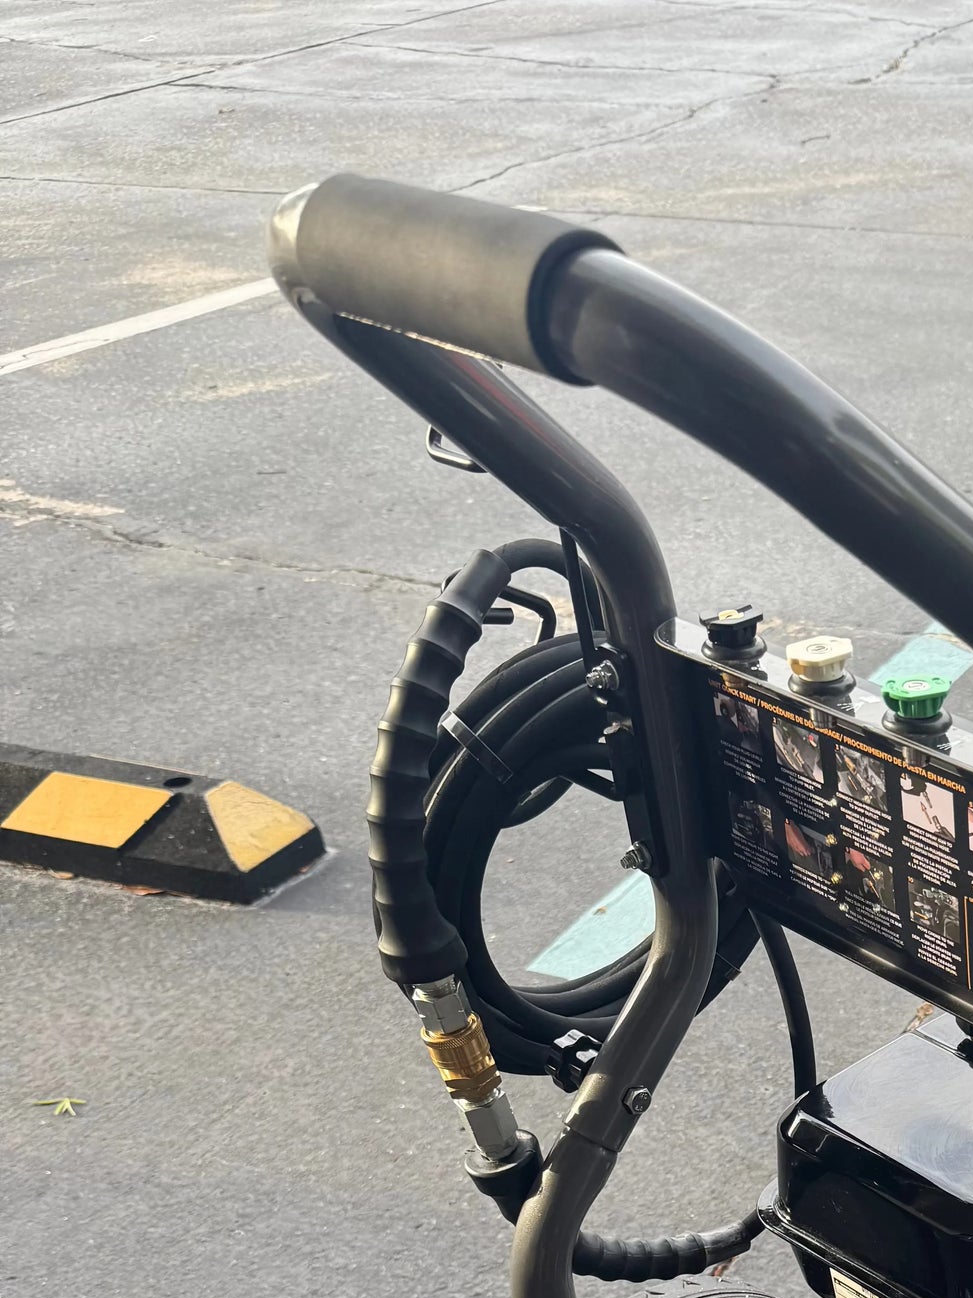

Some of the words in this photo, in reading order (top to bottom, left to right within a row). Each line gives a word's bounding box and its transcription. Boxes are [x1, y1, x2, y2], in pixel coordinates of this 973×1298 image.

[739, 691, 757, 705] START
[843, 735, 892, 763] PROCEDIMIENTO
[937, 775, 966, 795] MARCHA
